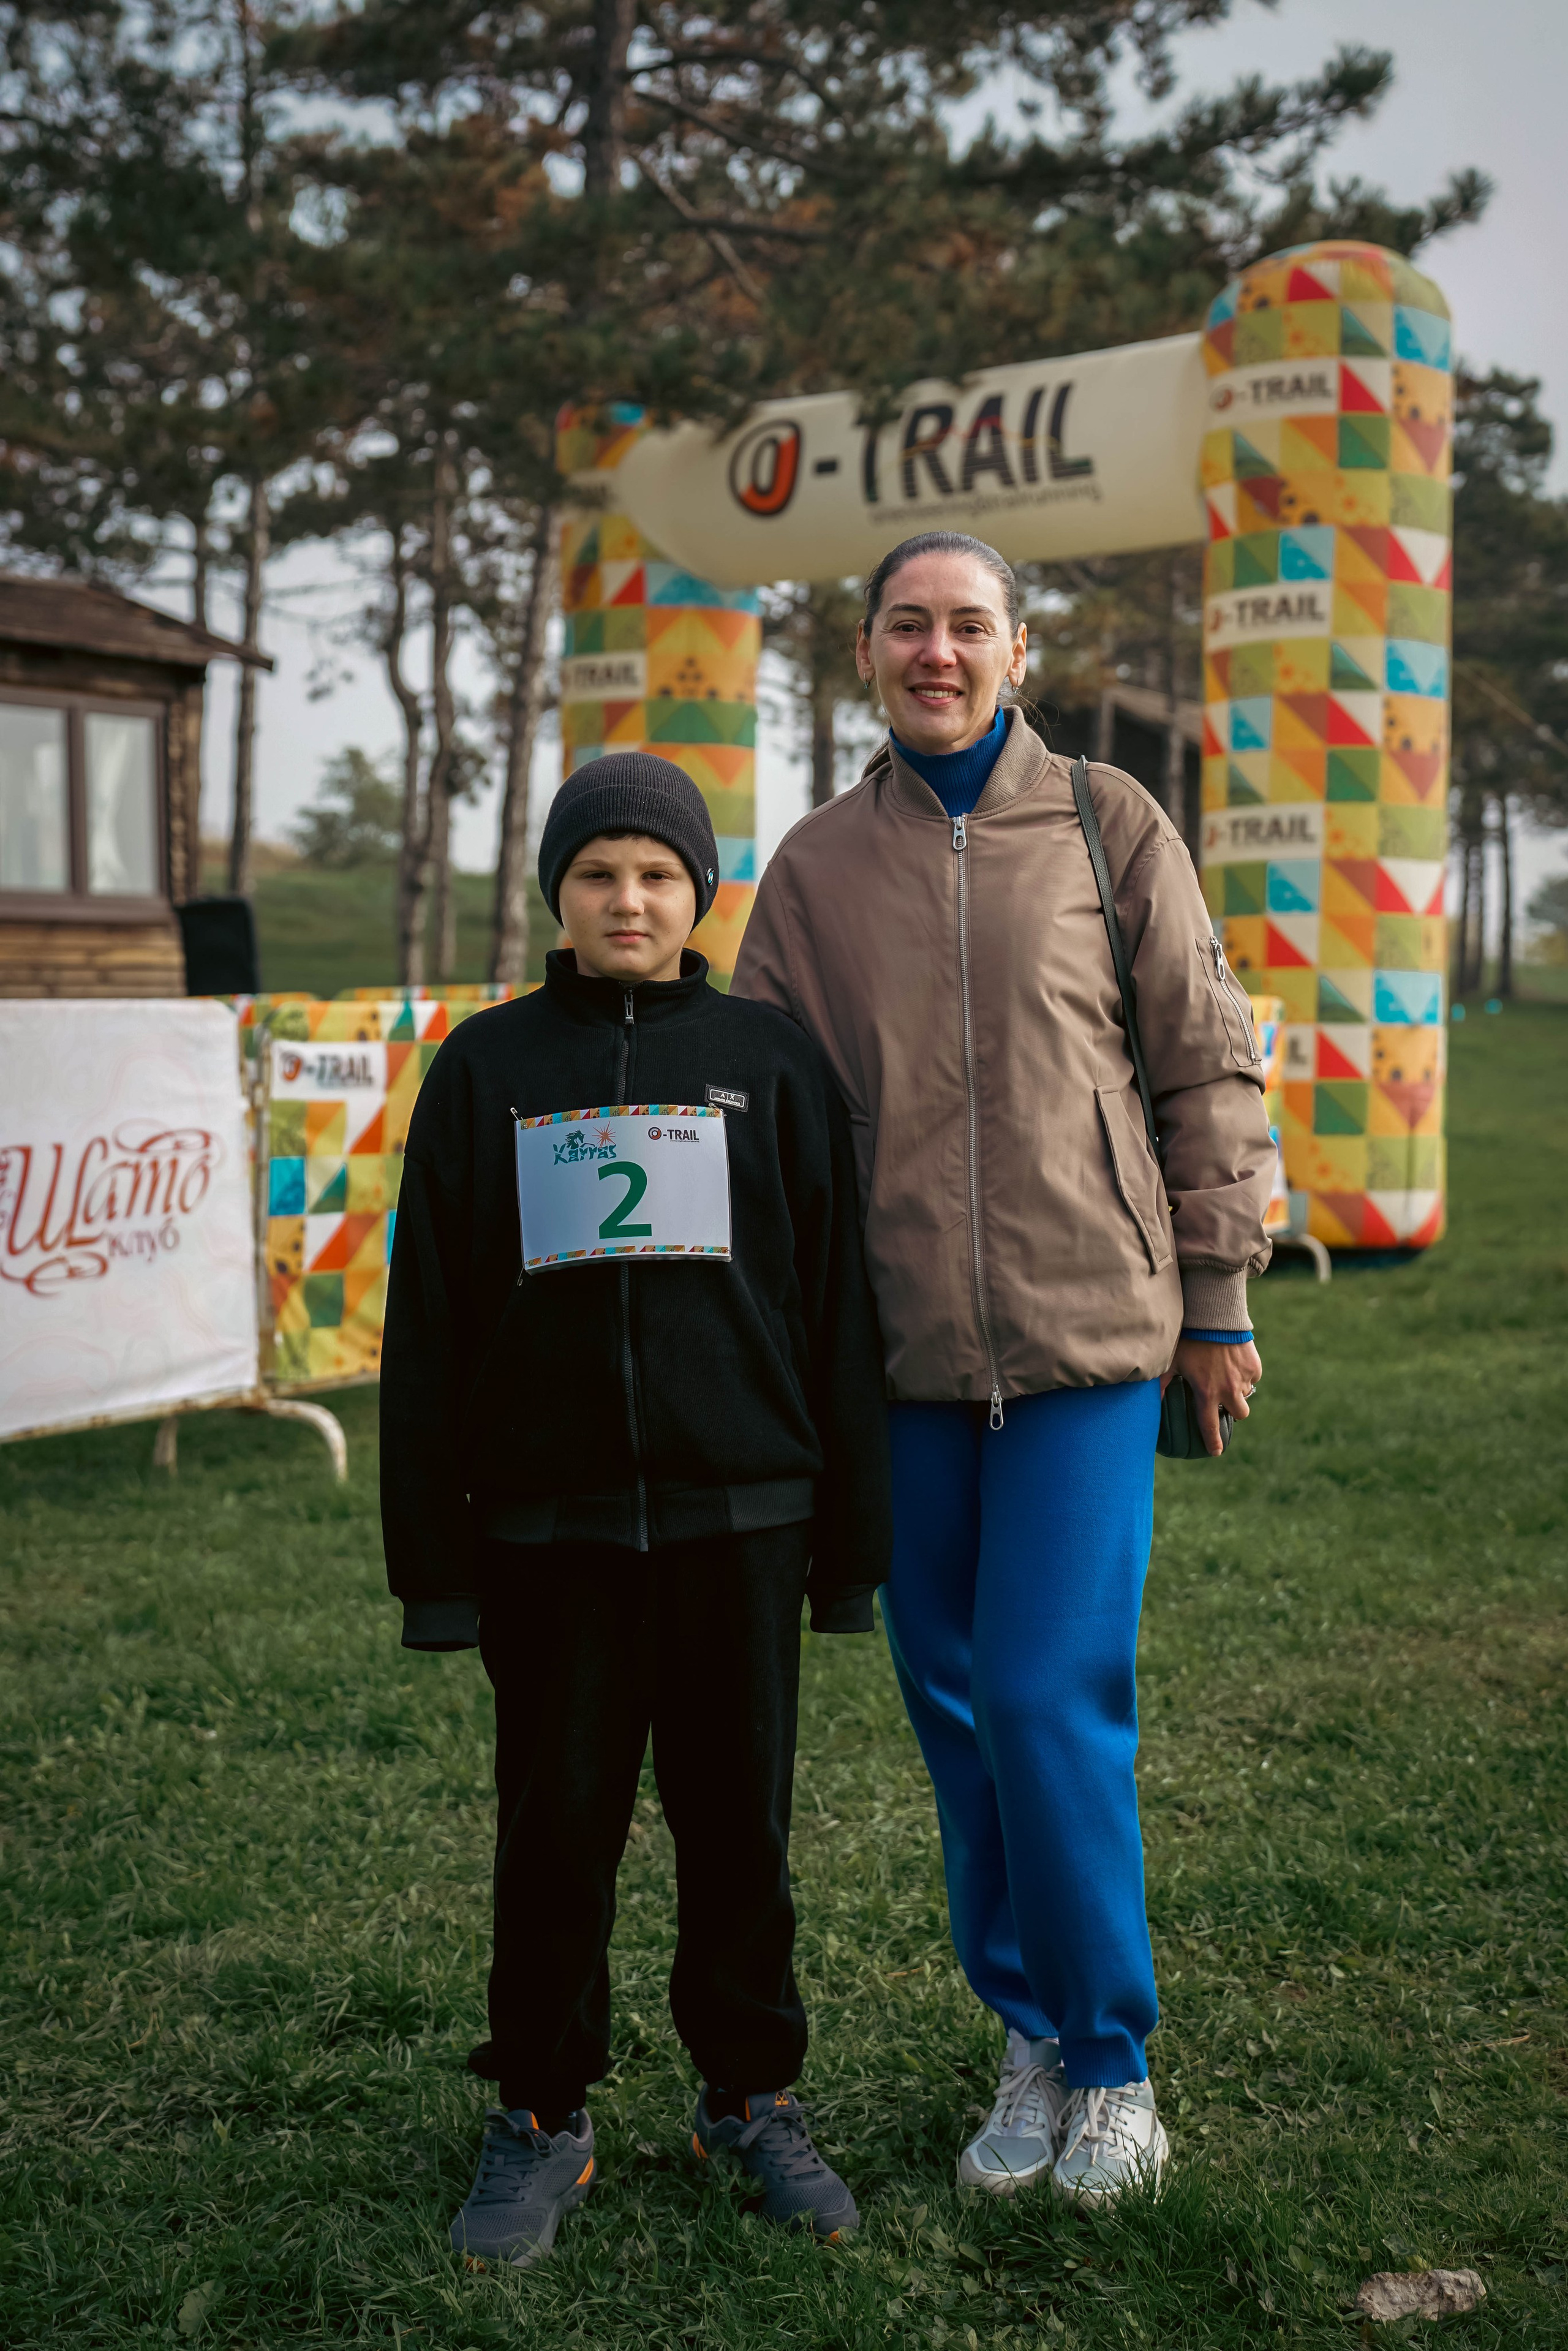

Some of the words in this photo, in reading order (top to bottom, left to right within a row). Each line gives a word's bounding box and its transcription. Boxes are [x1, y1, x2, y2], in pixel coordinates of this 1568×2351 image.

[1209, 371, 1333, 412] O-TRAIL
[648, 1126, 699, 1141] O-TRAIL
[552, 1142, 617, 1165] Karras
[597, 1161, 652, 1239] 2
